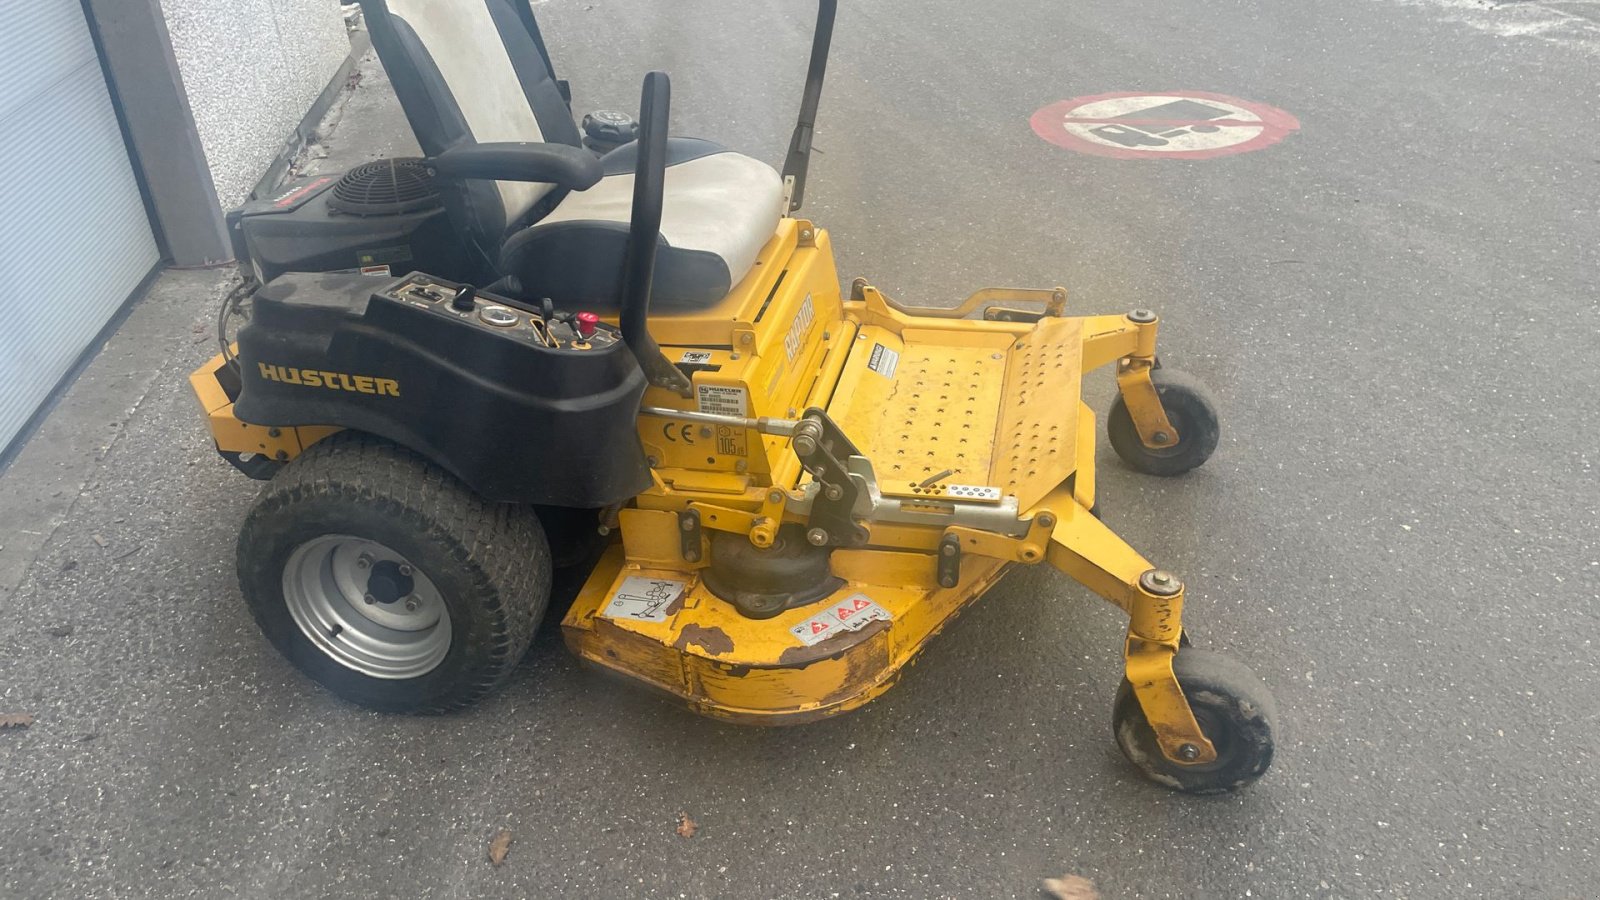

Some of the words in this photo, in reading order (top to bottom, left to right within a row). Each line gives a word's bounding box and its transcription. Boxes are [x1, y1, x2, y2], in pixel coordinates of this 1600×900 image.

[784, 292, 815, 363] RAPTOR
[258, 362, 400, 396] HUSTLER
[663, 422, 695, 444] CE
[720, 437, 736, 454] 105
